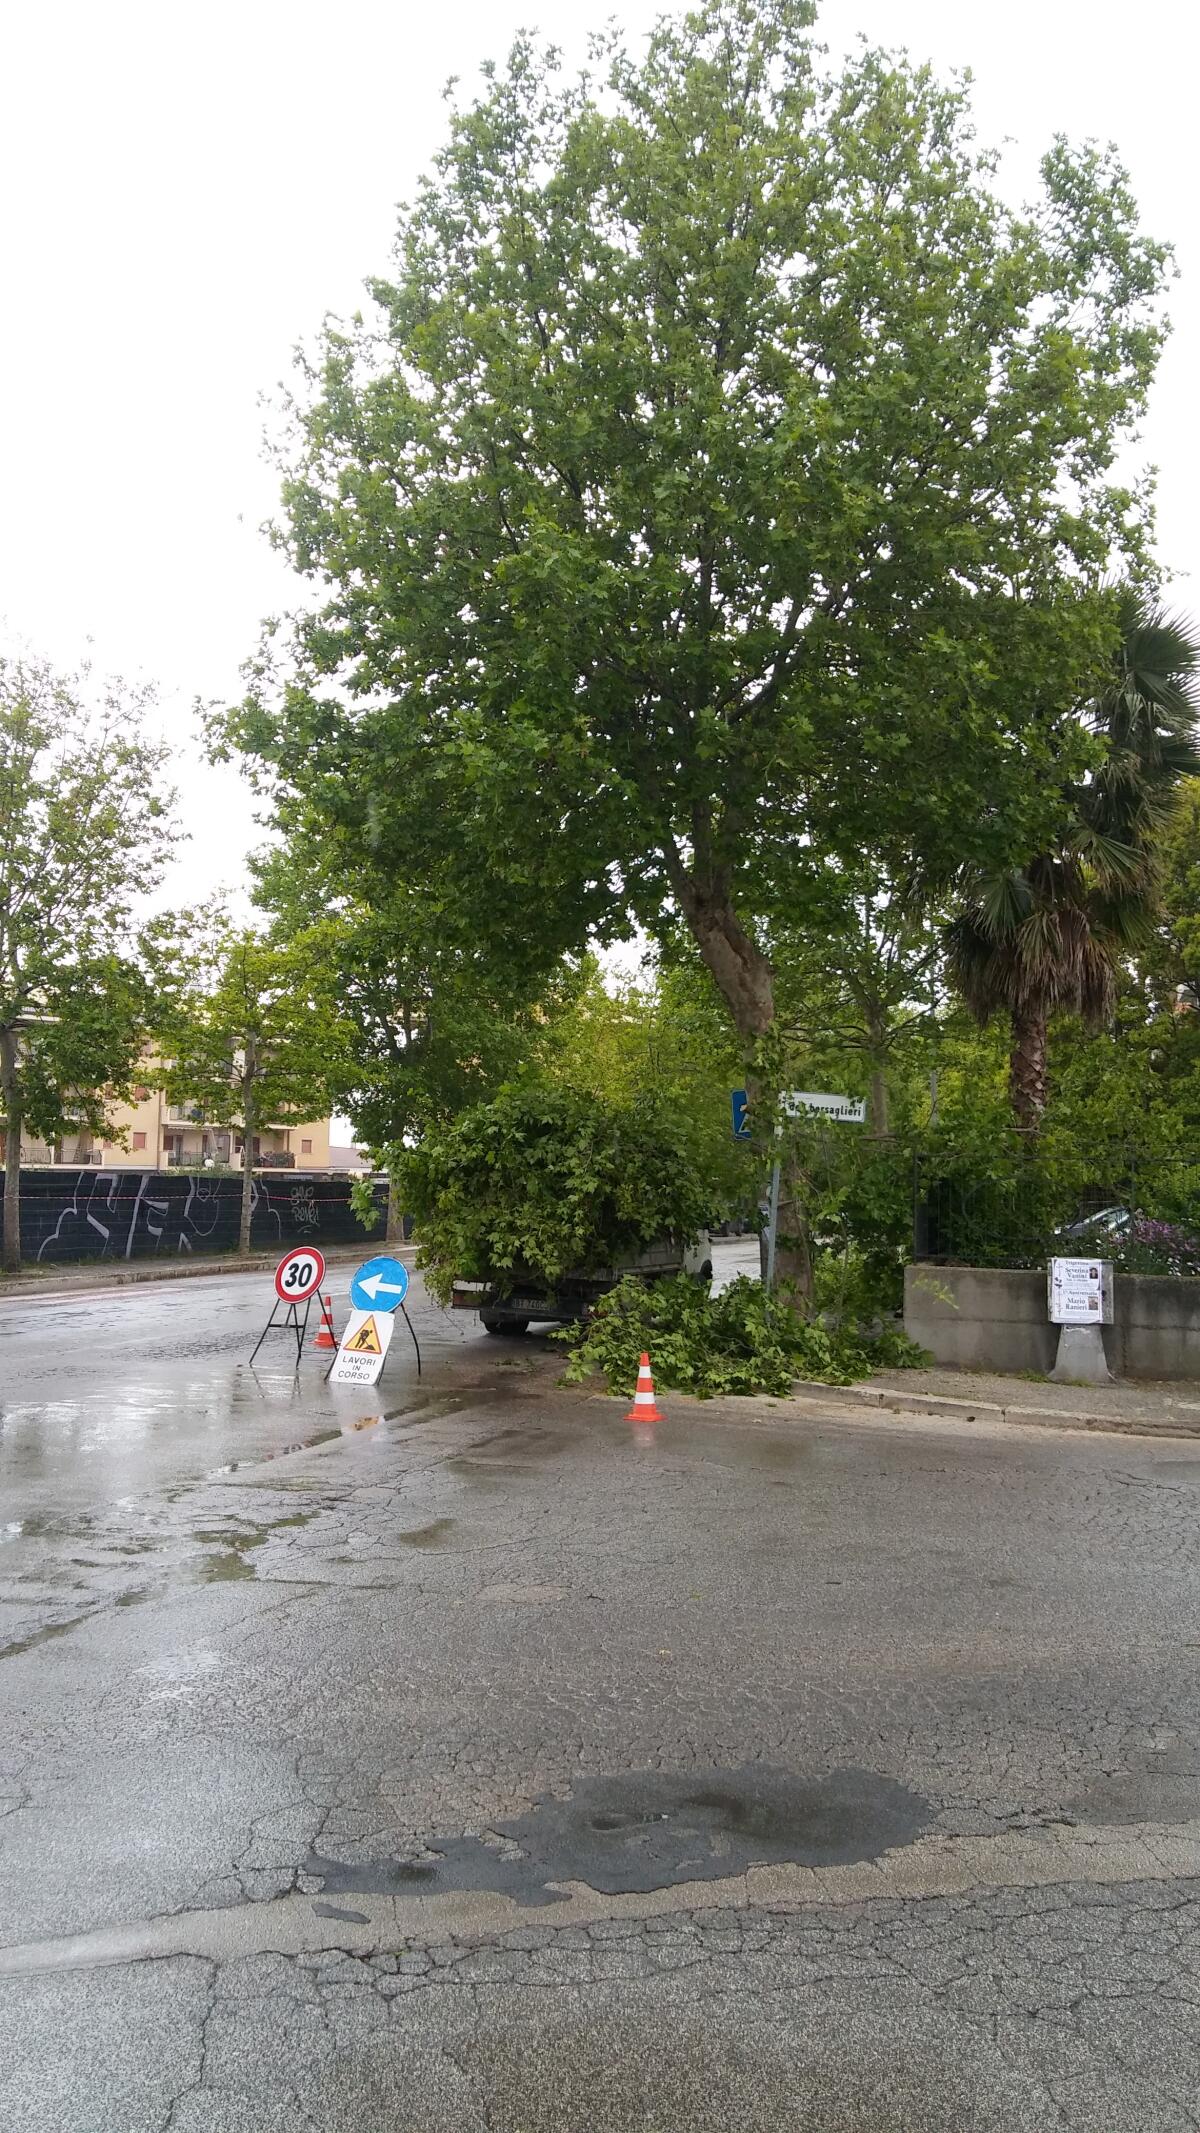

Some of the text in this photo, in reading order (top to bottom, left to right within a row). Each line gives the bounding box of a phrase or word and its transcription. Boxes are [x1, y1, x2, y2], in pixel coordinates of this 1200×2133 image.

[810, 1103, 862, 1119] bersaglieri
[285, 1263, 312, 1287] 30
[342, 1355, 377, 1366] LAVORI
[337, 1370, 371, 1380] CORSO
